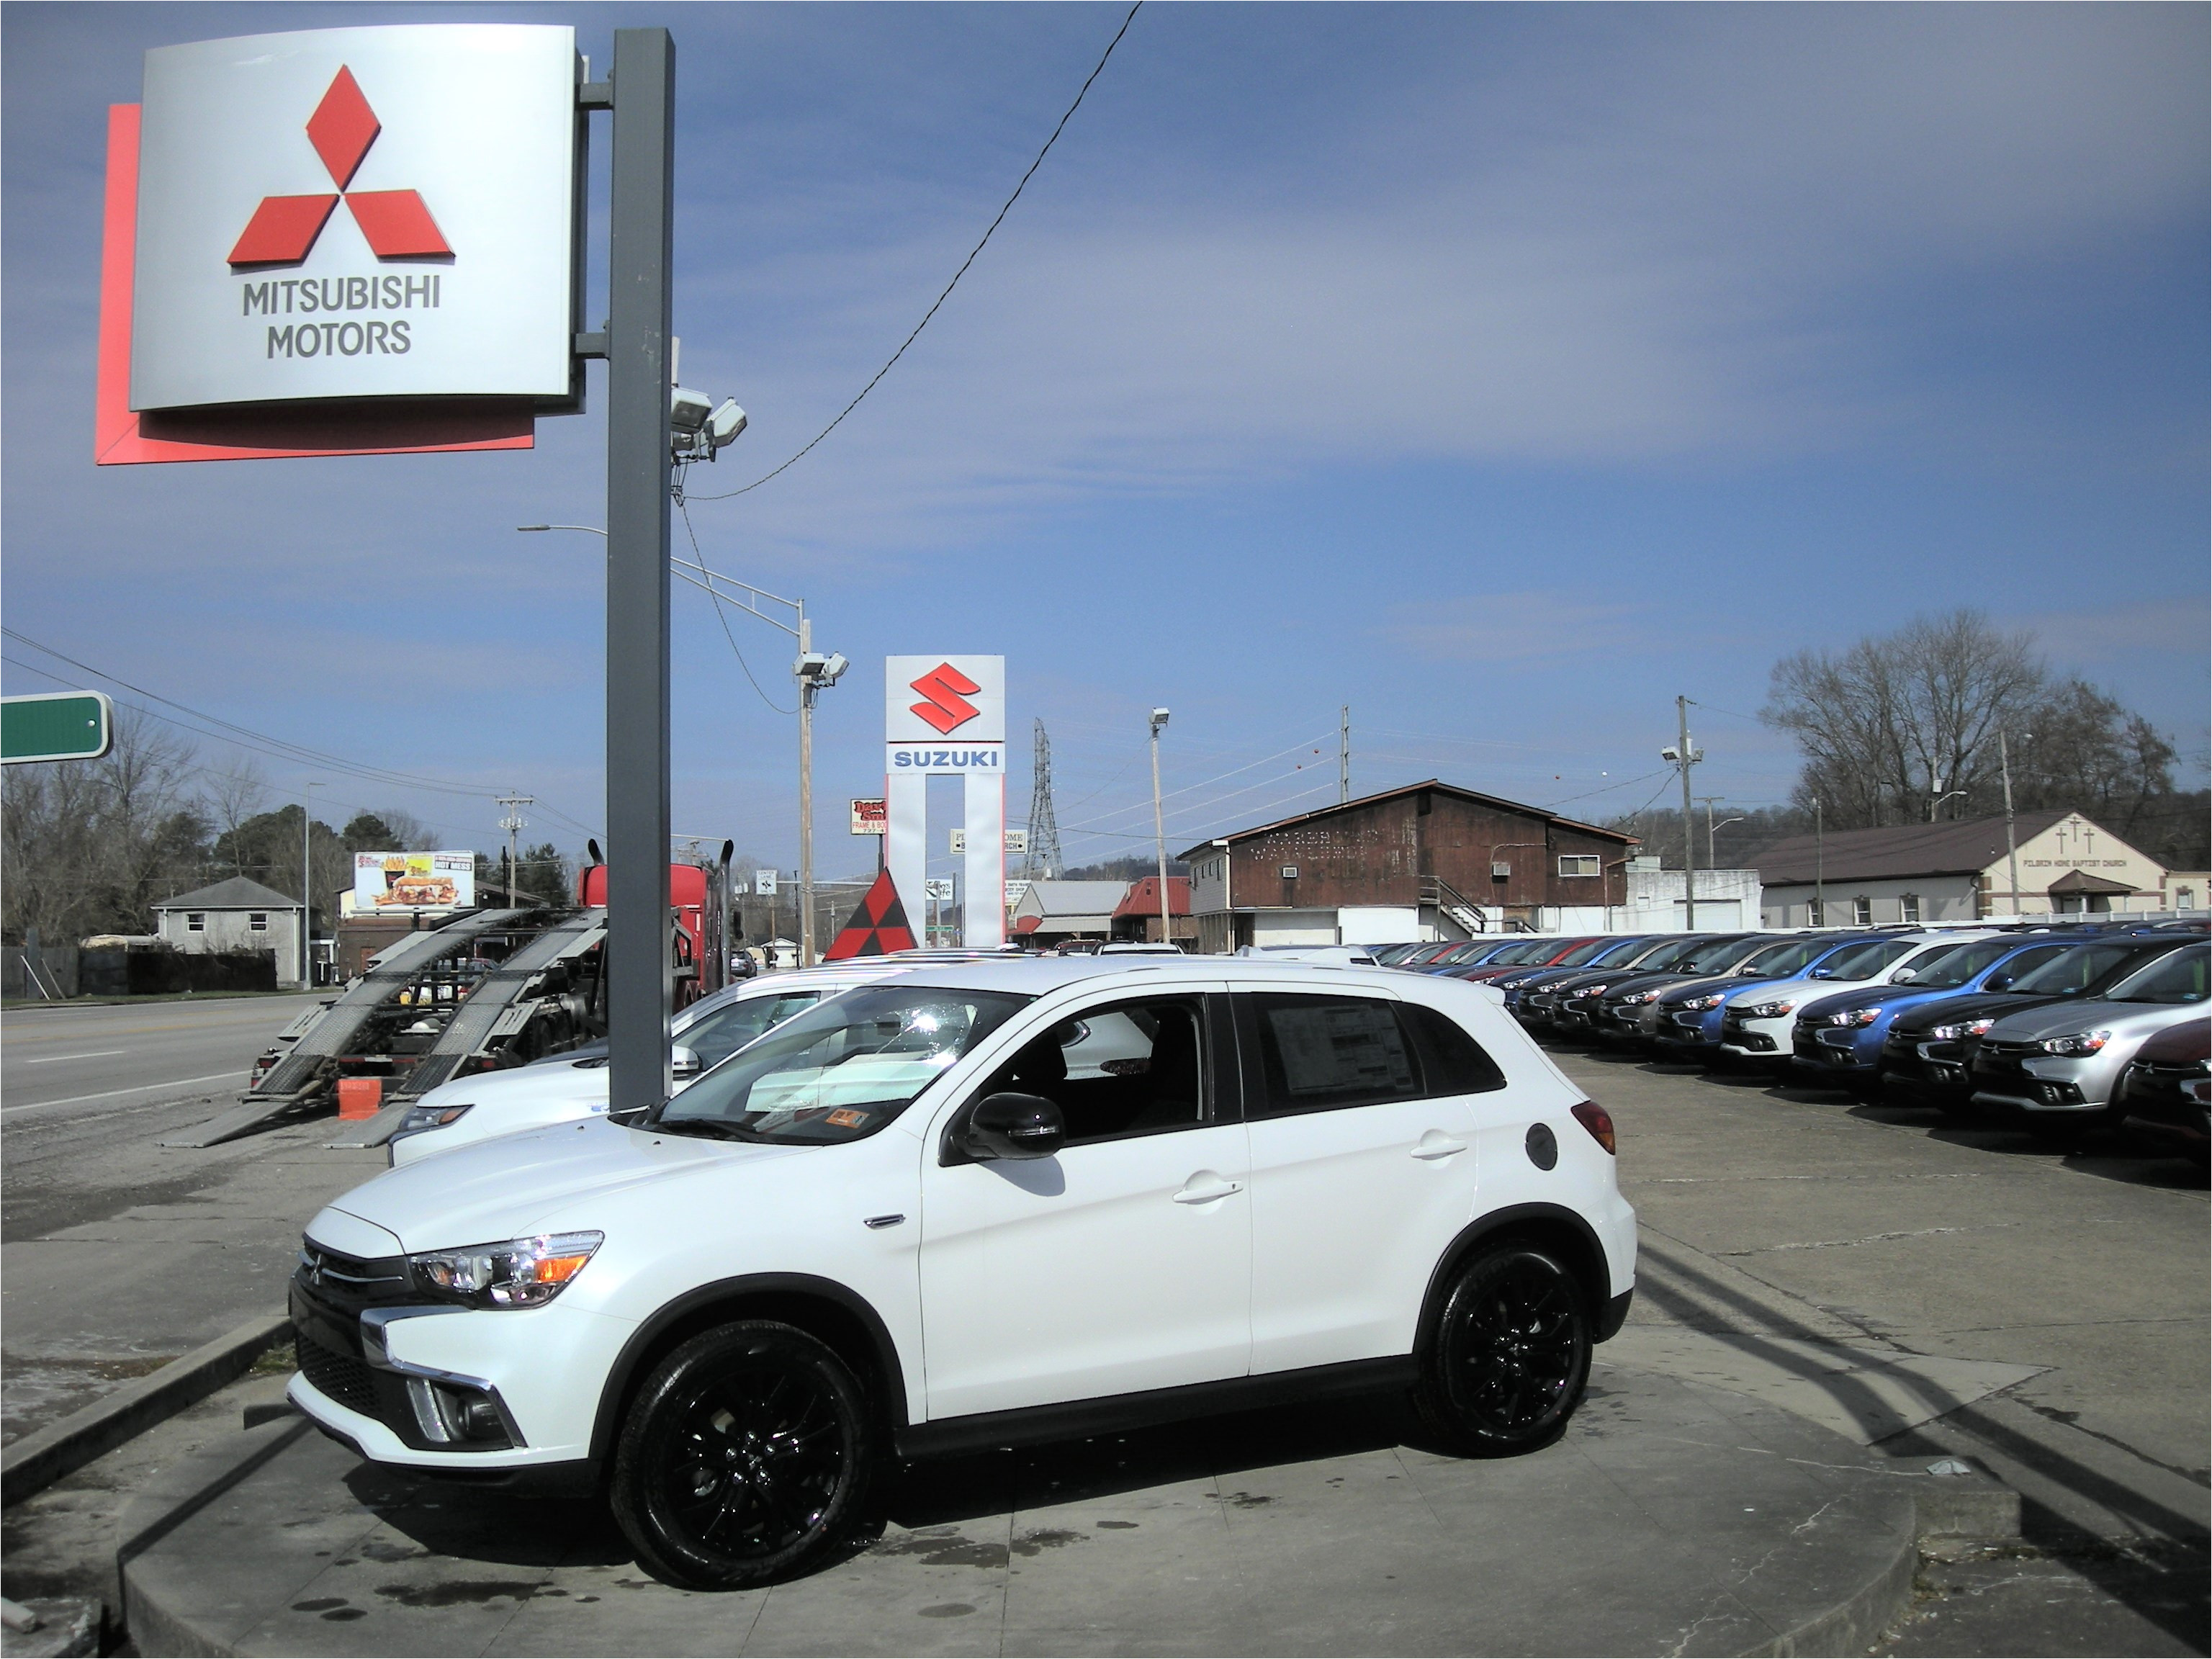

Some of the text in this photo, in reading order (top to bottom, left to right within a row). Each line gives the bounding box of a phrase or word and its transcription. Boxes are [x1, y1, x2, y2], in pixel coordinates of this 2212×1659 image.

[243, 275, 440, 316] MITSUBISHI
[267, 320, 411, 359] MOTORS
[894, 751, 997, 767] SUZUKI
[435, 860, 471, 871] HOT MESS
